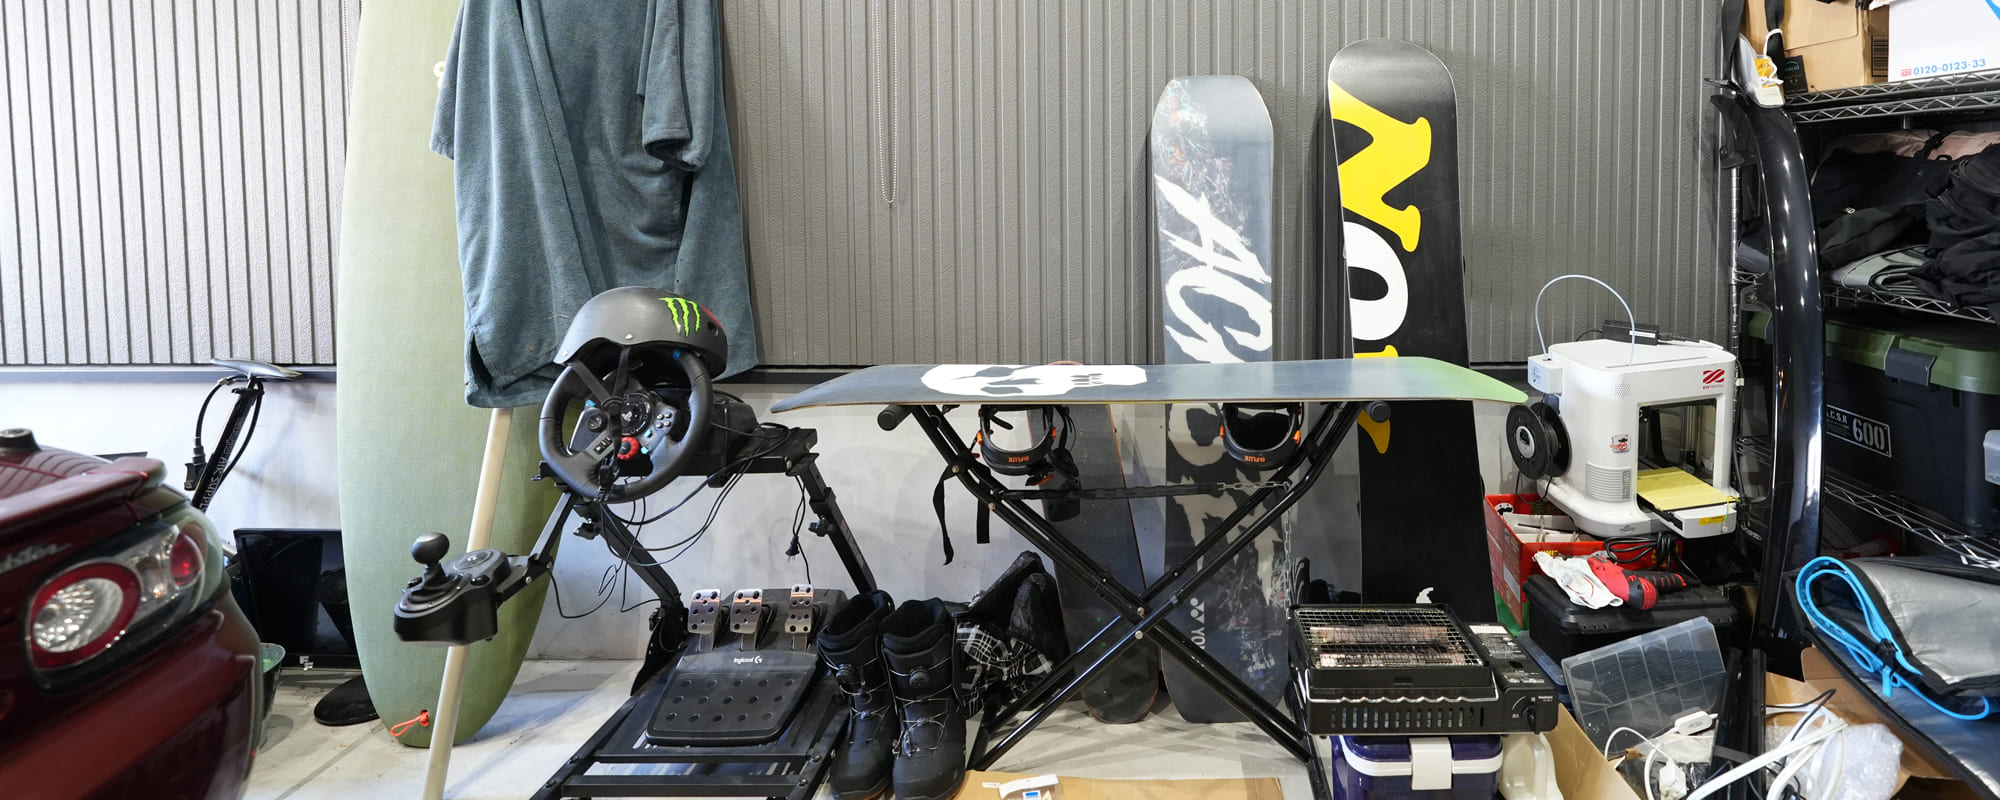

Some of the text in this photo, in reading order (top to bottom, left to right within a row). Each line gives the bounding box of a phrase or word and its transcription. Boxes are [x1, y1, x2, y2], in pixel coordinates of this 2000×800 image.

[1913, 58, 1986, 75] 0120-0123-33
[1852, 417, 1885, 450] 600
[1244, 455, 1260, 463] FLUX
